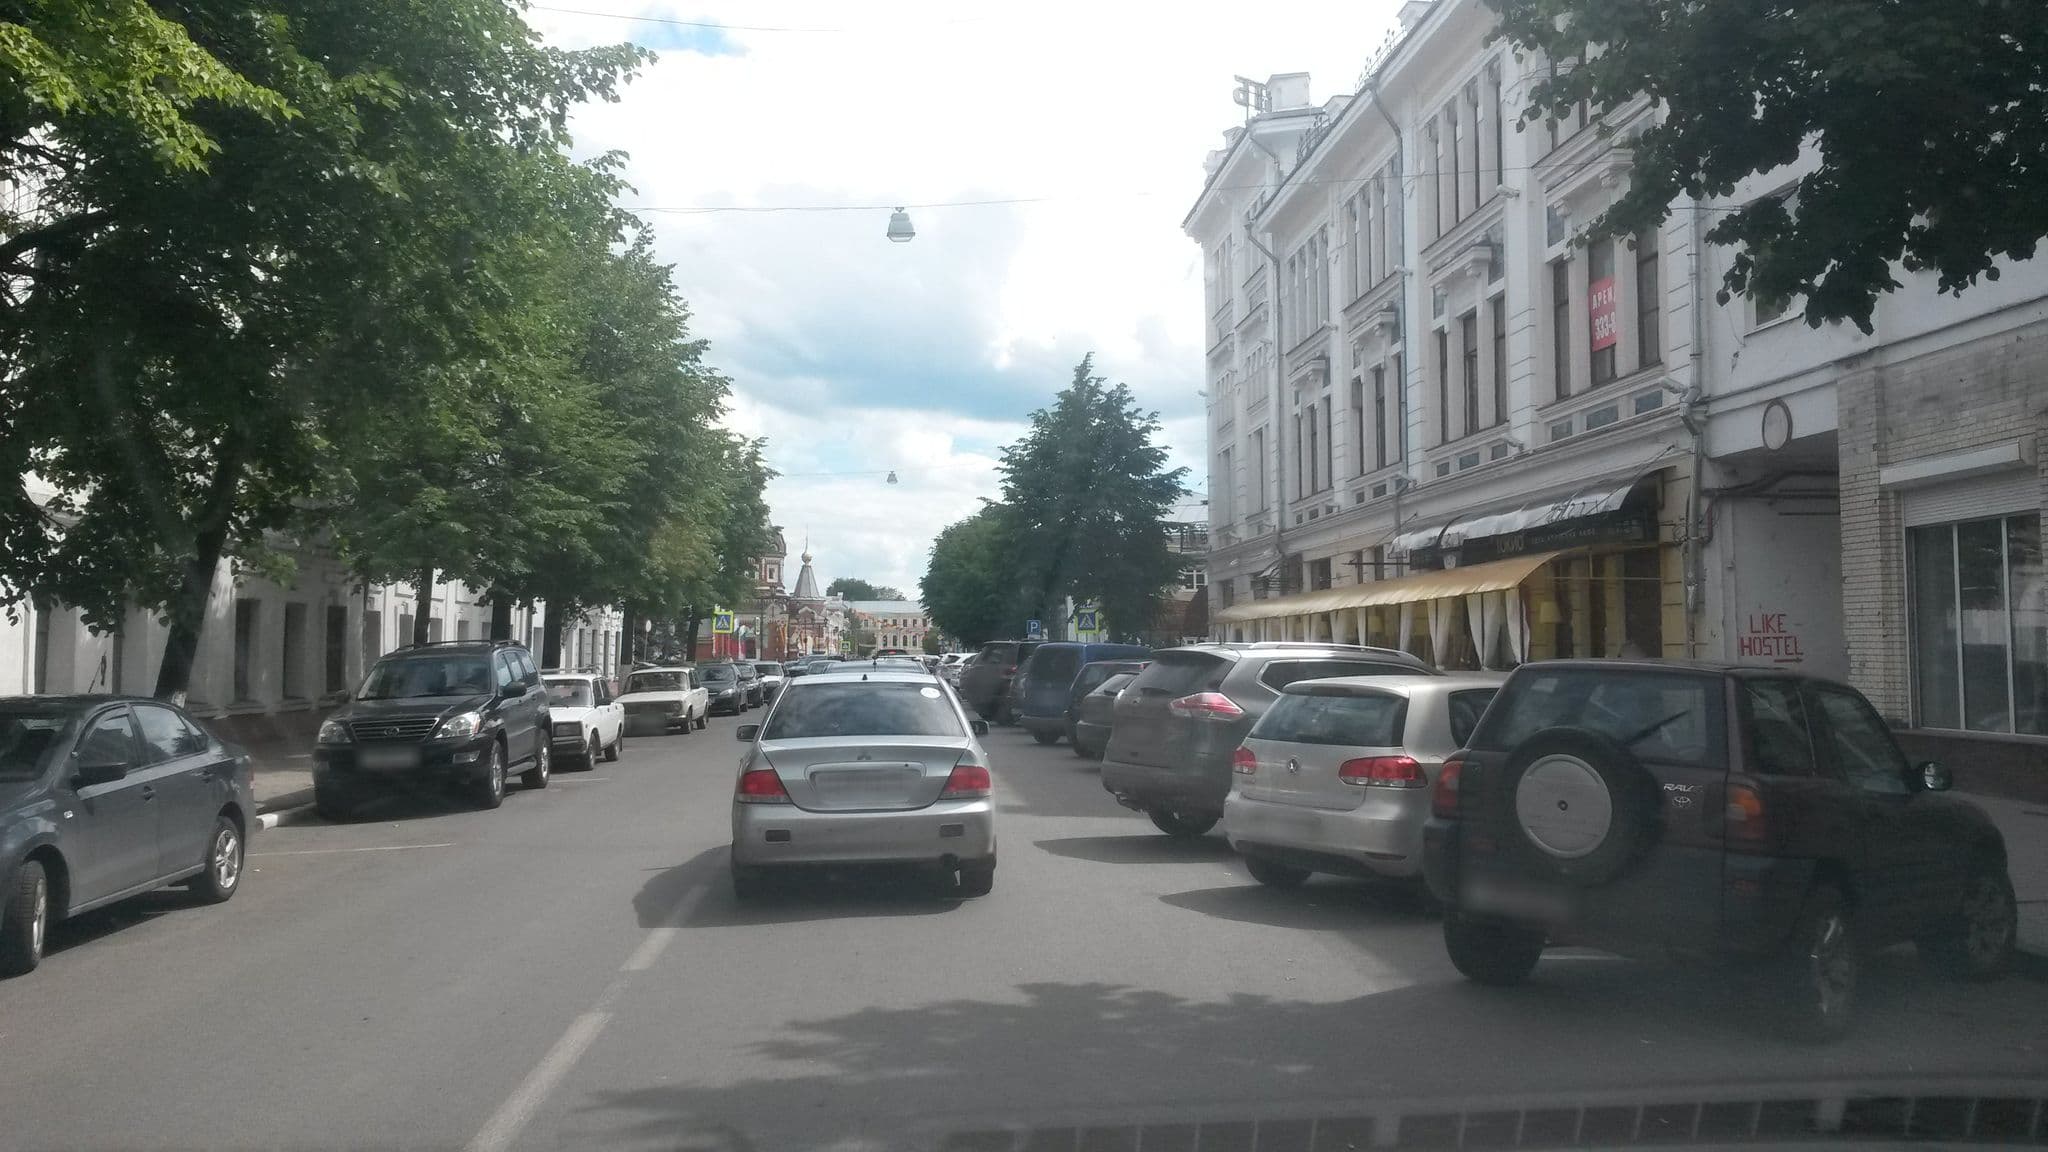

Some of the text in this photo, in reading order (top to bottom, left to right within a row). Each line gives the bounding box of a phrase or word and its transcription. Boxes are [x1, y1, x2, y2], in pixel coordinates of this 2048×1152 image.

[1592, 286, 1616, 310] АРЕН
[1030, 621, 1038, 632] P
[1750, 613, 1787, 634] LIKE
[1740, 635, 1804, 657] HOSTEL
